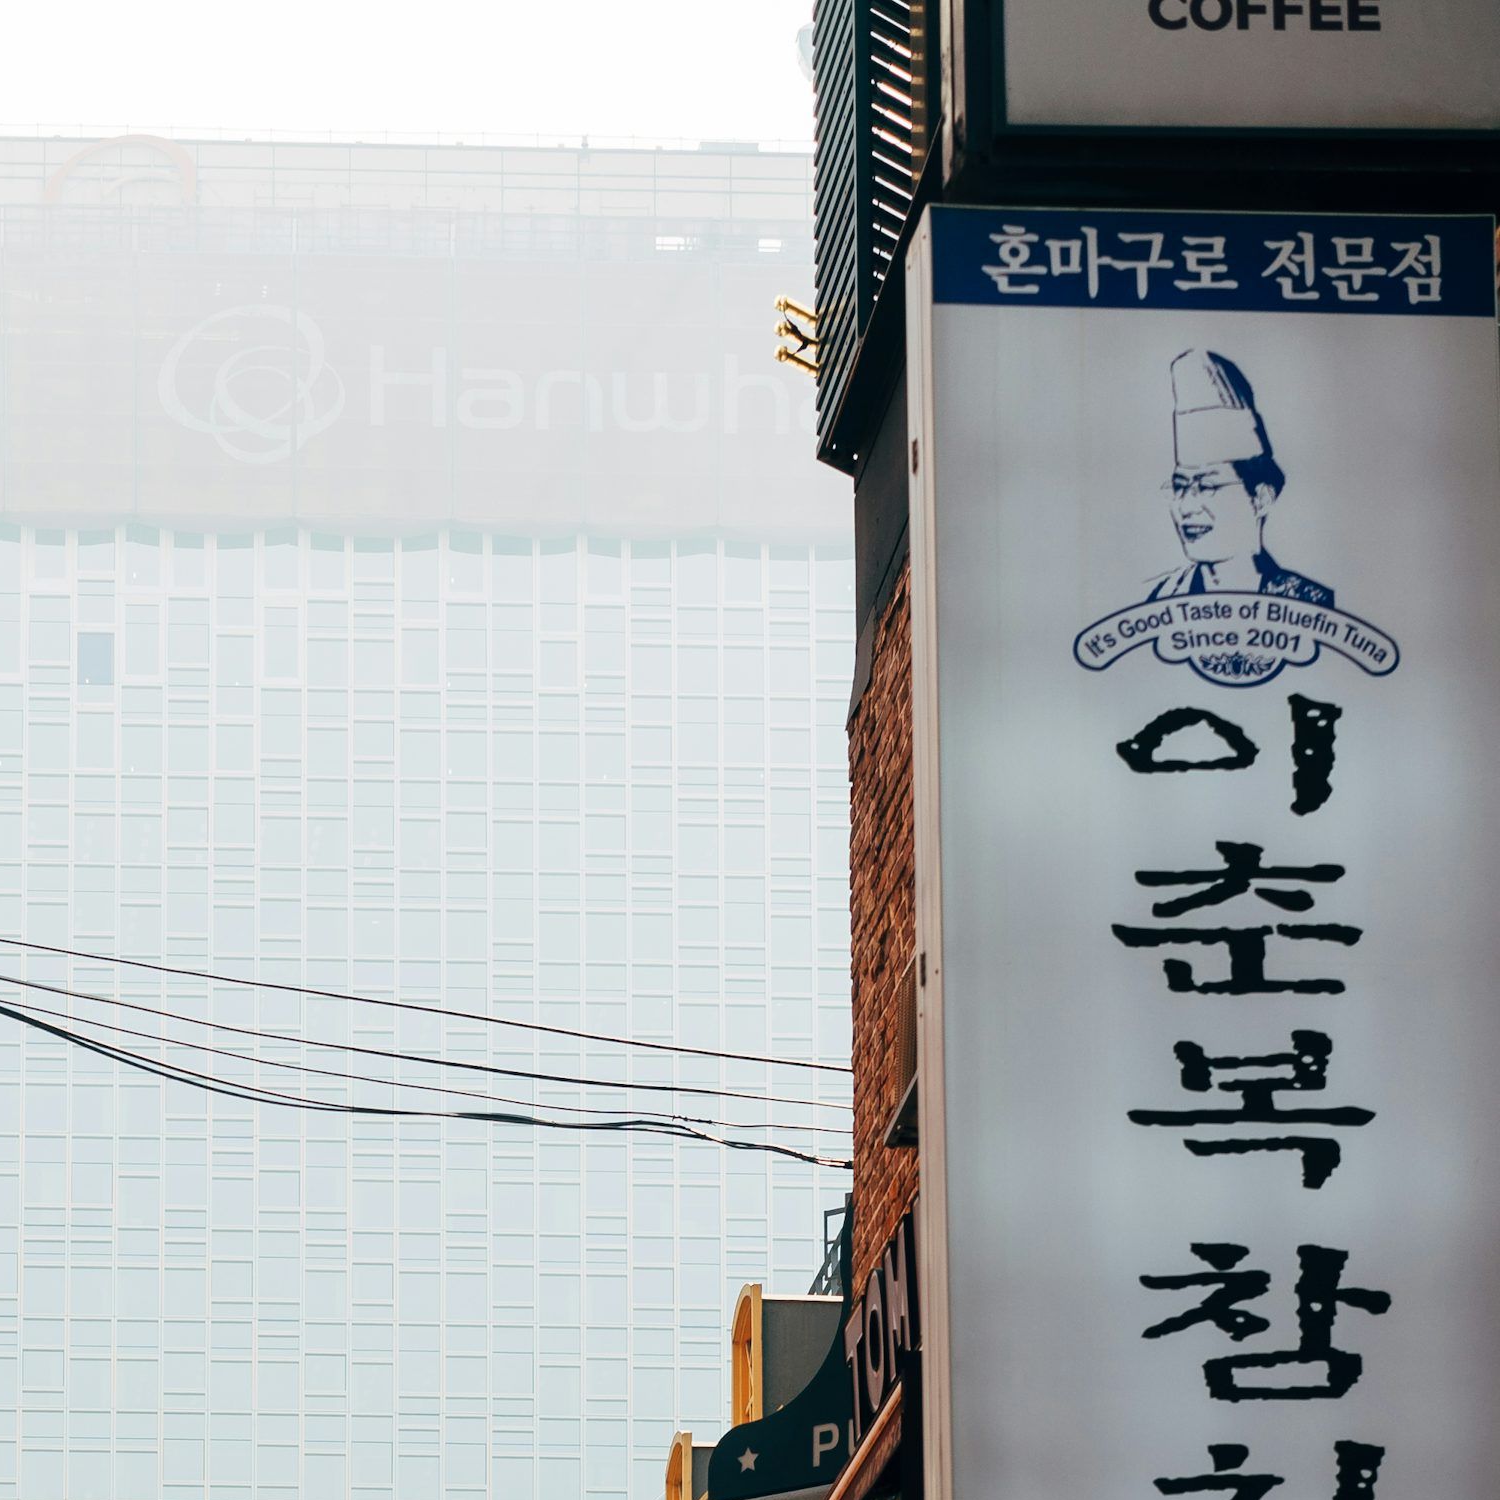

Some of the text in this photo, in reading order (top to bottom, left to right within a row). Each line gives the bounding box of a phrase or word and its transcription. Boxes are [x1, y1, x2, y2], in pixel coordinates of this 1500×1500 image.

[1148, 0, 1382, 33] COFFEE
[981, 224, 1443, 305] 혼마구로 전문점
[1083, 598, 1390, 667] It's Good Taste of Bluefin Tuna
[1171, 626, 1303, 655] Since 2001
